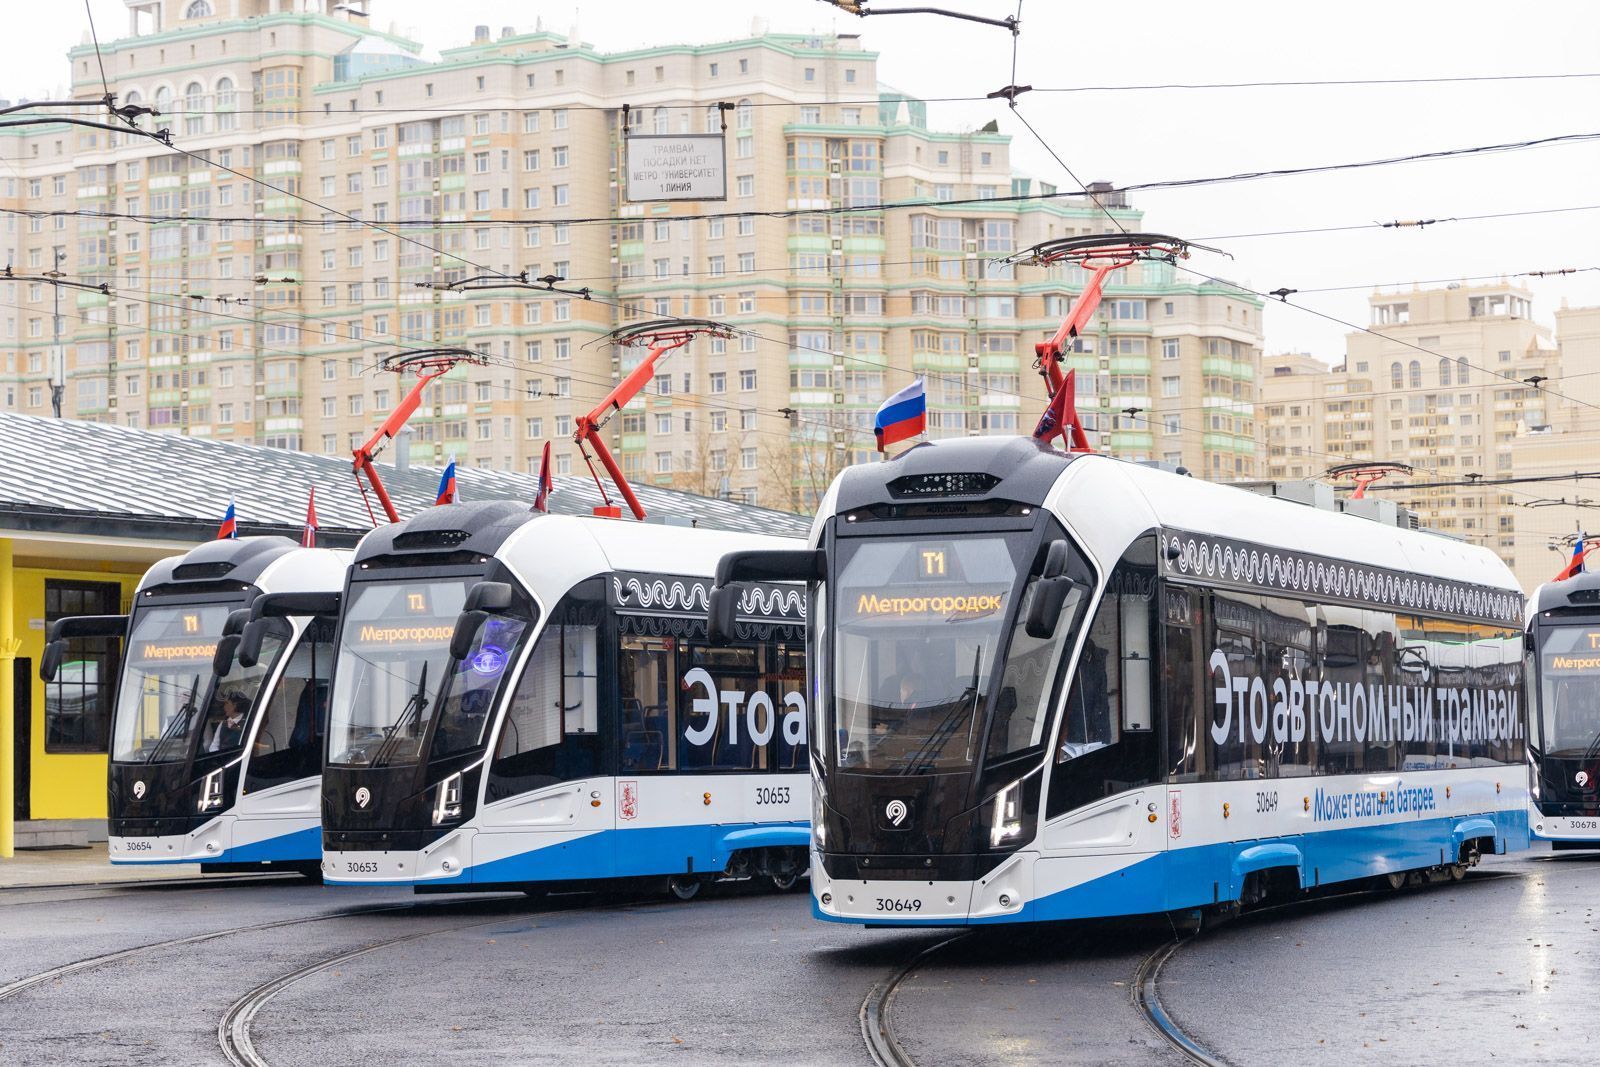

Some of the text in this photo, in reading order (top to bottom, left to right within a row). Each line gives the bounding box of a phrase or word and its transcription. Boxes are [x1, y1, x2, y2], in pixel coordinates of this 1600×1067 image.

[653, 143, 695, 155] ТРАМВАЙ
[643, 155, 707, 168] ПОСАДКИ НЕТ
[633, 170, 658, 181] МЕТРО
[660, 182, 692, 193] 1 ЛИНИЯ
[857, 594, 1001, 616] Метрогородок
[1588, 633, 1600, 649] Т
[684, 667, 807, 747] Это а
[1210, 648, 1524, 760] Это автономный трамвай.
[756, 787, 790, 805] 30653
[1256, 791, 1278, 813] 30649
[1314, 787, 1353, 822] Может
[1354, 792, 1382, 818] ехать
[1397, 780, 1436, 818] батарее.
[1570, 820, 1597, 829] 30678
[126, 841, 152, 851] 30654
[347, 862, 378, 873] 30653
[876, 898, 922, 912] 30649
